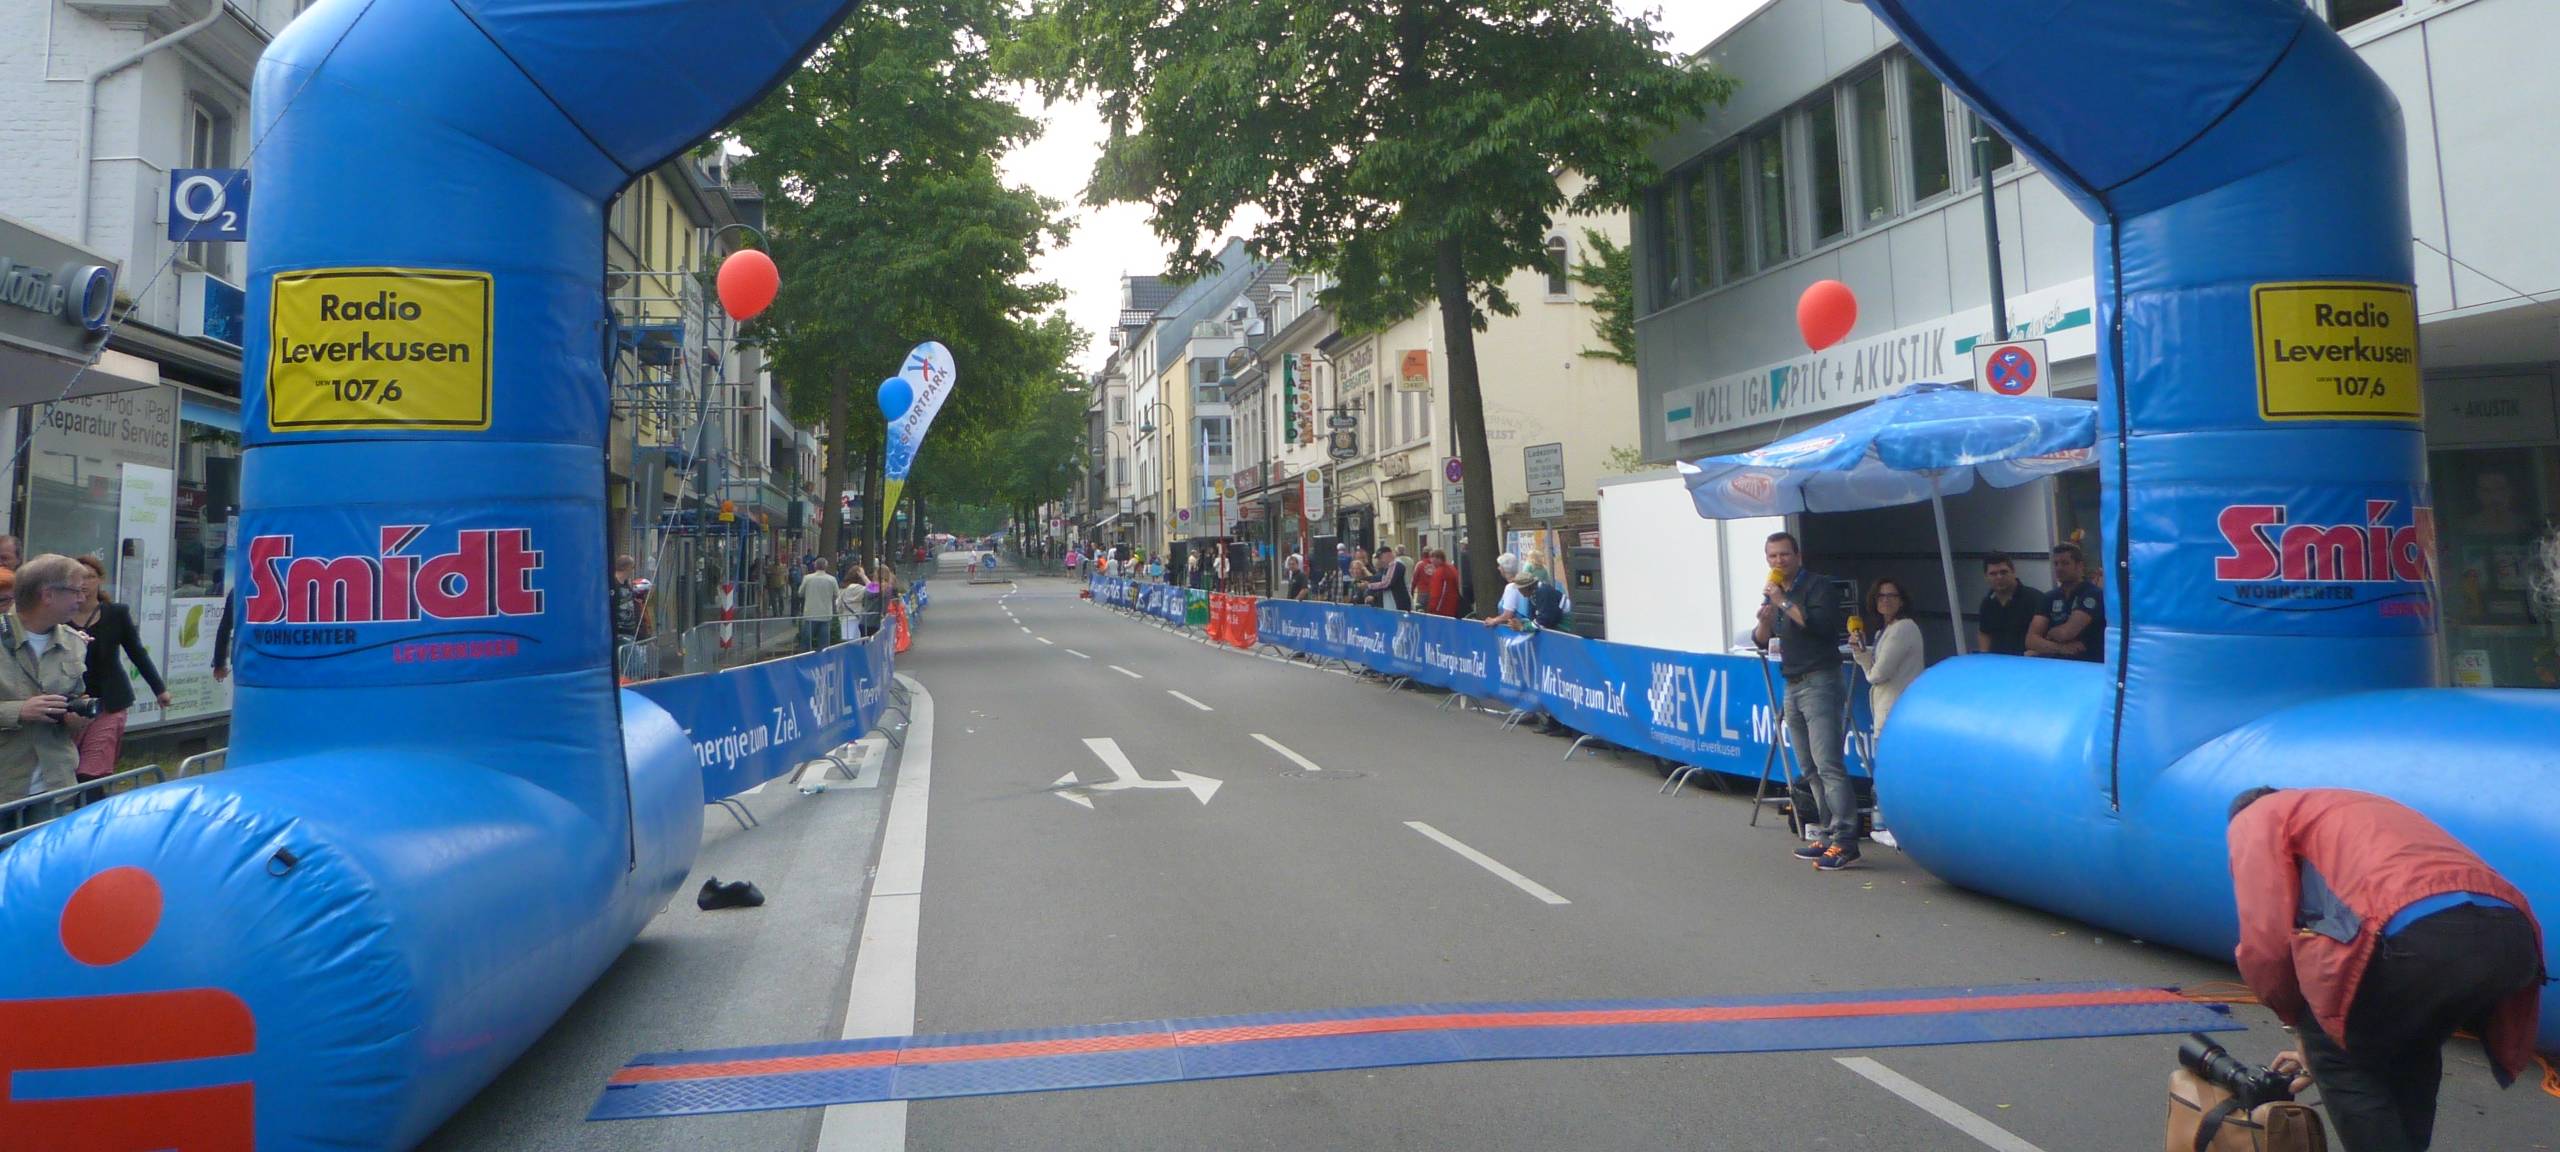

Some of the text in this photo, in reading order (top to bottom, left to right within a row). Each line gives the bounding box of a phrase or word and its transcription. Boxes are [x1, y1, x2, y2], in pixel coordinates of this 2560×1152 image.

[320, 291, 422, 321] Radio
[2315, 303, 2389, 328] Radio
[281, 331, 470, 364] Leverkusen
[2273, 336, 2412, 364] Leverkusen
[331, 379, 402, 405] 107,6
[1694, 391, 1732, 428] MOLL
[1742, 376, 1769, 418] IGA
[1779, 358, 1827, 410] OPTIC
[1853, 327, 1945, 394] AKUSTIK
[2334, 376, 2386, 399] 107,6
[105, 393, 133, 416] iPod
[145, 399, 170, 425] iPad
[901, 366, 948, 444] SPORTPARK
[43, 404, 169, 448] Reparatur Service
[2215, 500, 2437, 583] Smid
[245, 524, 545, 624] Smidt
[2234, 585, 2354, 600] WOHNCENTER
[254, 628, 357, 647] WOHNCENTER
[393, 638, 519, 664] LEVERKUSEN
[1542, 664, 1557, 695] Mit
[1557, 668, 1584, 710] Energie
[1585, 687, 1604, 711] zum
[1674, 666, 1739, 740] EVL
[684, 729, 748, 769] nergie
[749, 724, 769, 753] zum
